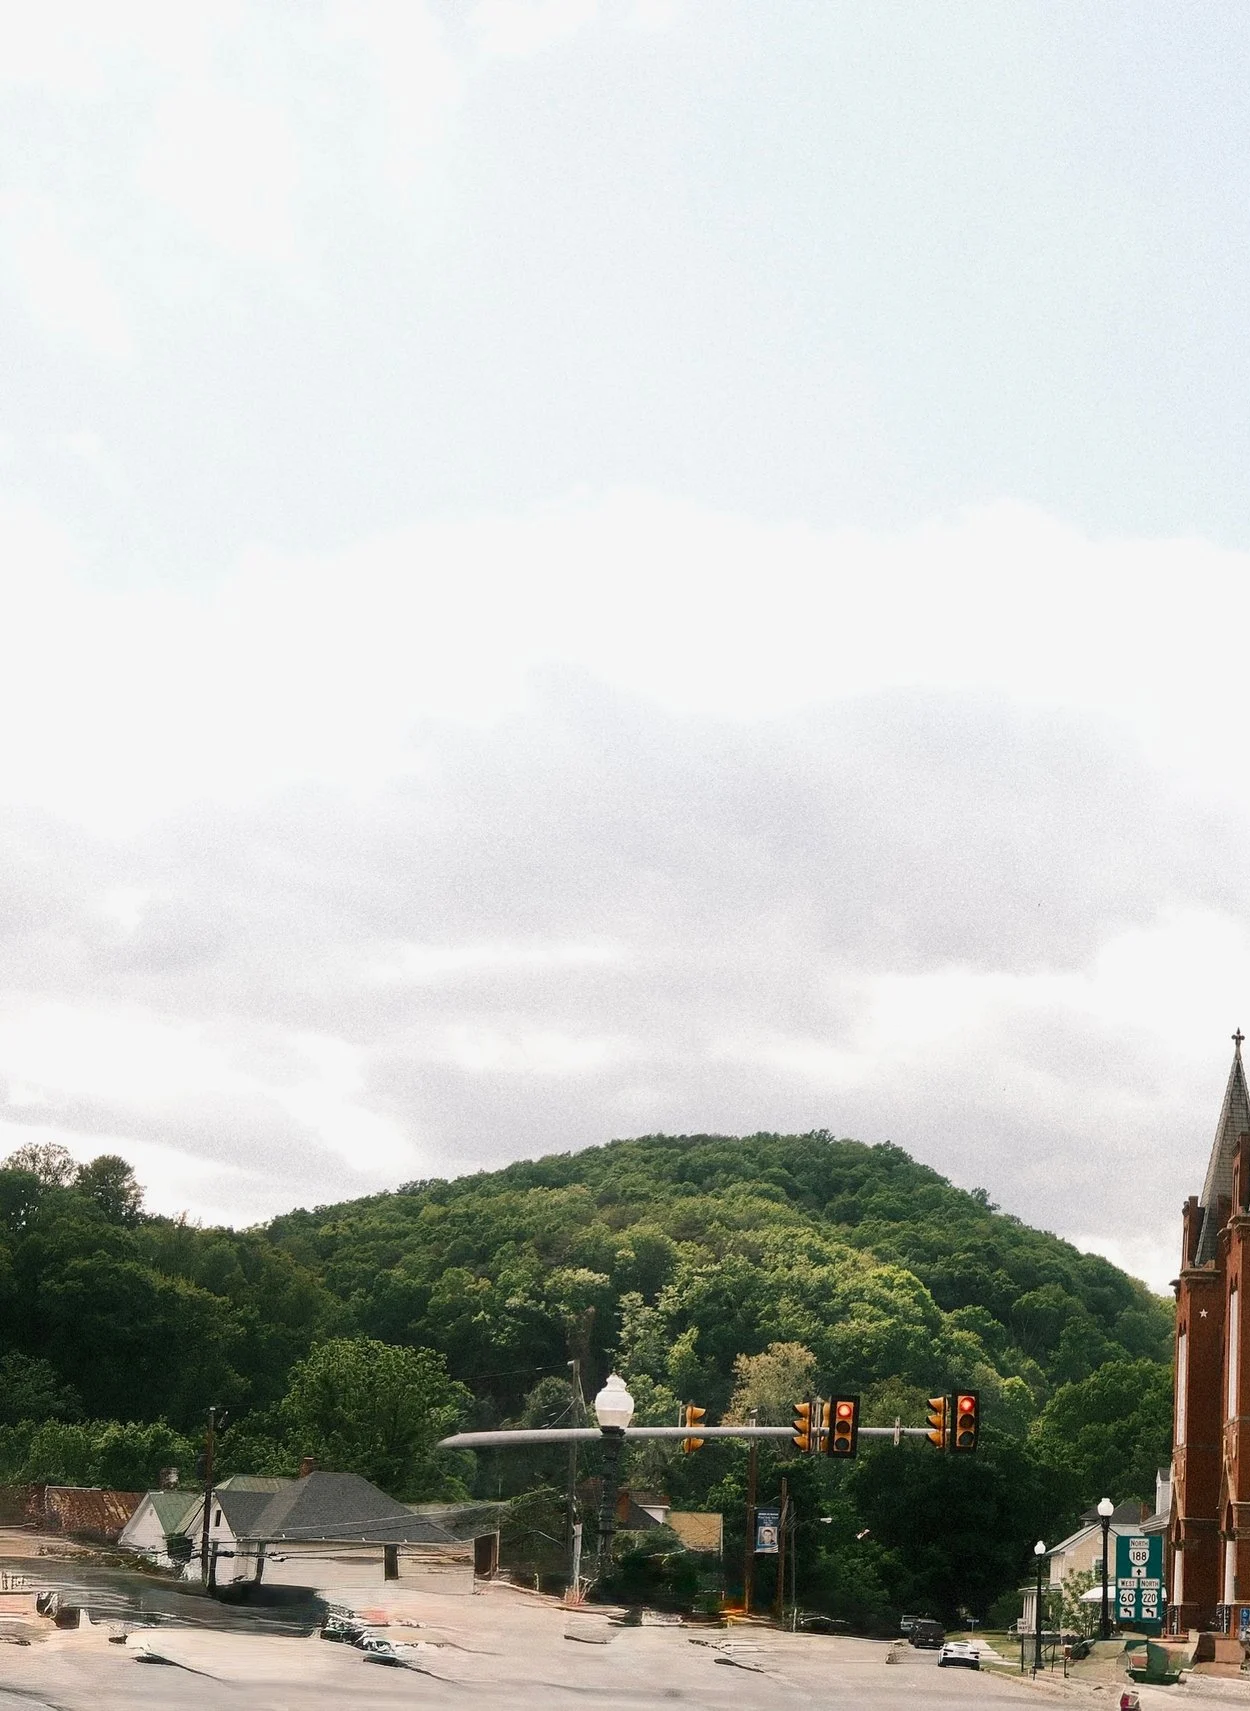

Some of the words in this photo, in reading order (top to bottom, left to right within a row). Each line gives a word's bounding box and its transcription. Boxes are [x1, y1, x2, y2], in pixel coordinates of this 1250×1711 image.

[1132, 1551, 1147, 1561] 188
[1121, 1593, 1135, 1603] 60
[1143, 1593, 1156, 1603] 220
